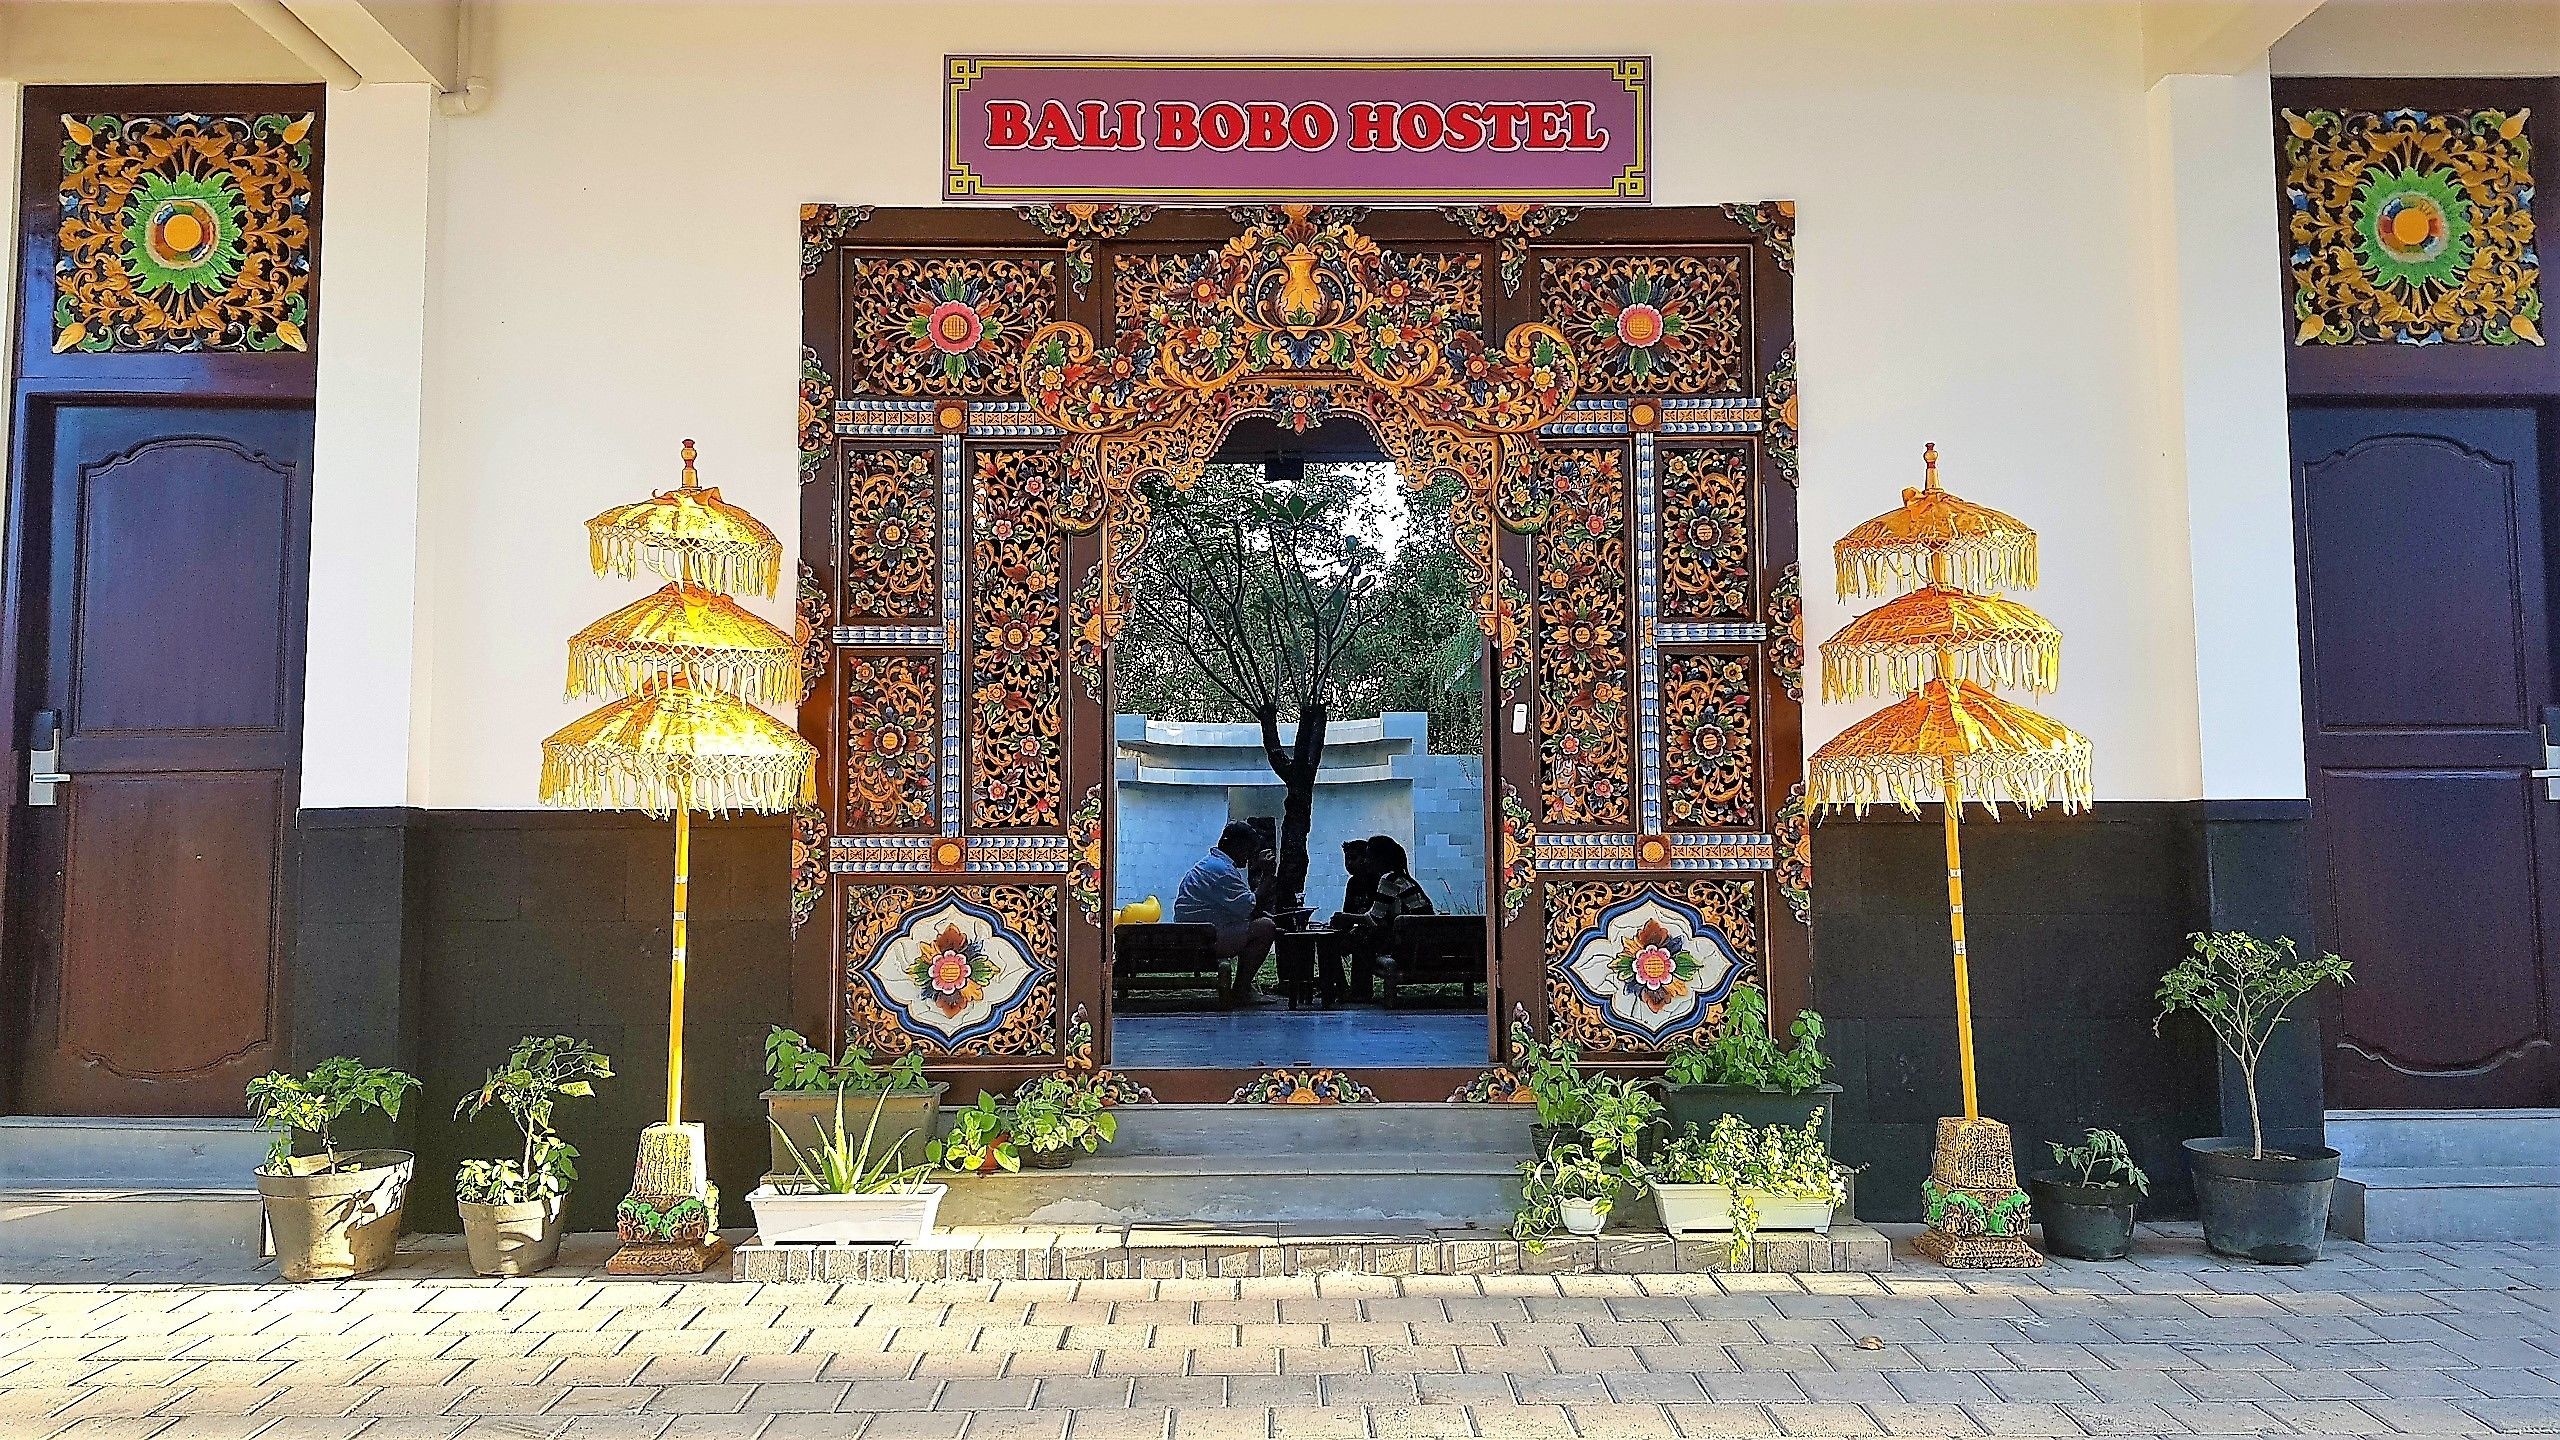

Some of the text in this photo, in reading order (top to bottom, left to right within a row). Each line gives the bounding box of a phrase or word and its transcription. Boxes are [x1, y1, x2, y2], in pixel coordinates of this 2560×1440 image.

[985, 100, 1610, 153] BALI BOBO HOSTEL
